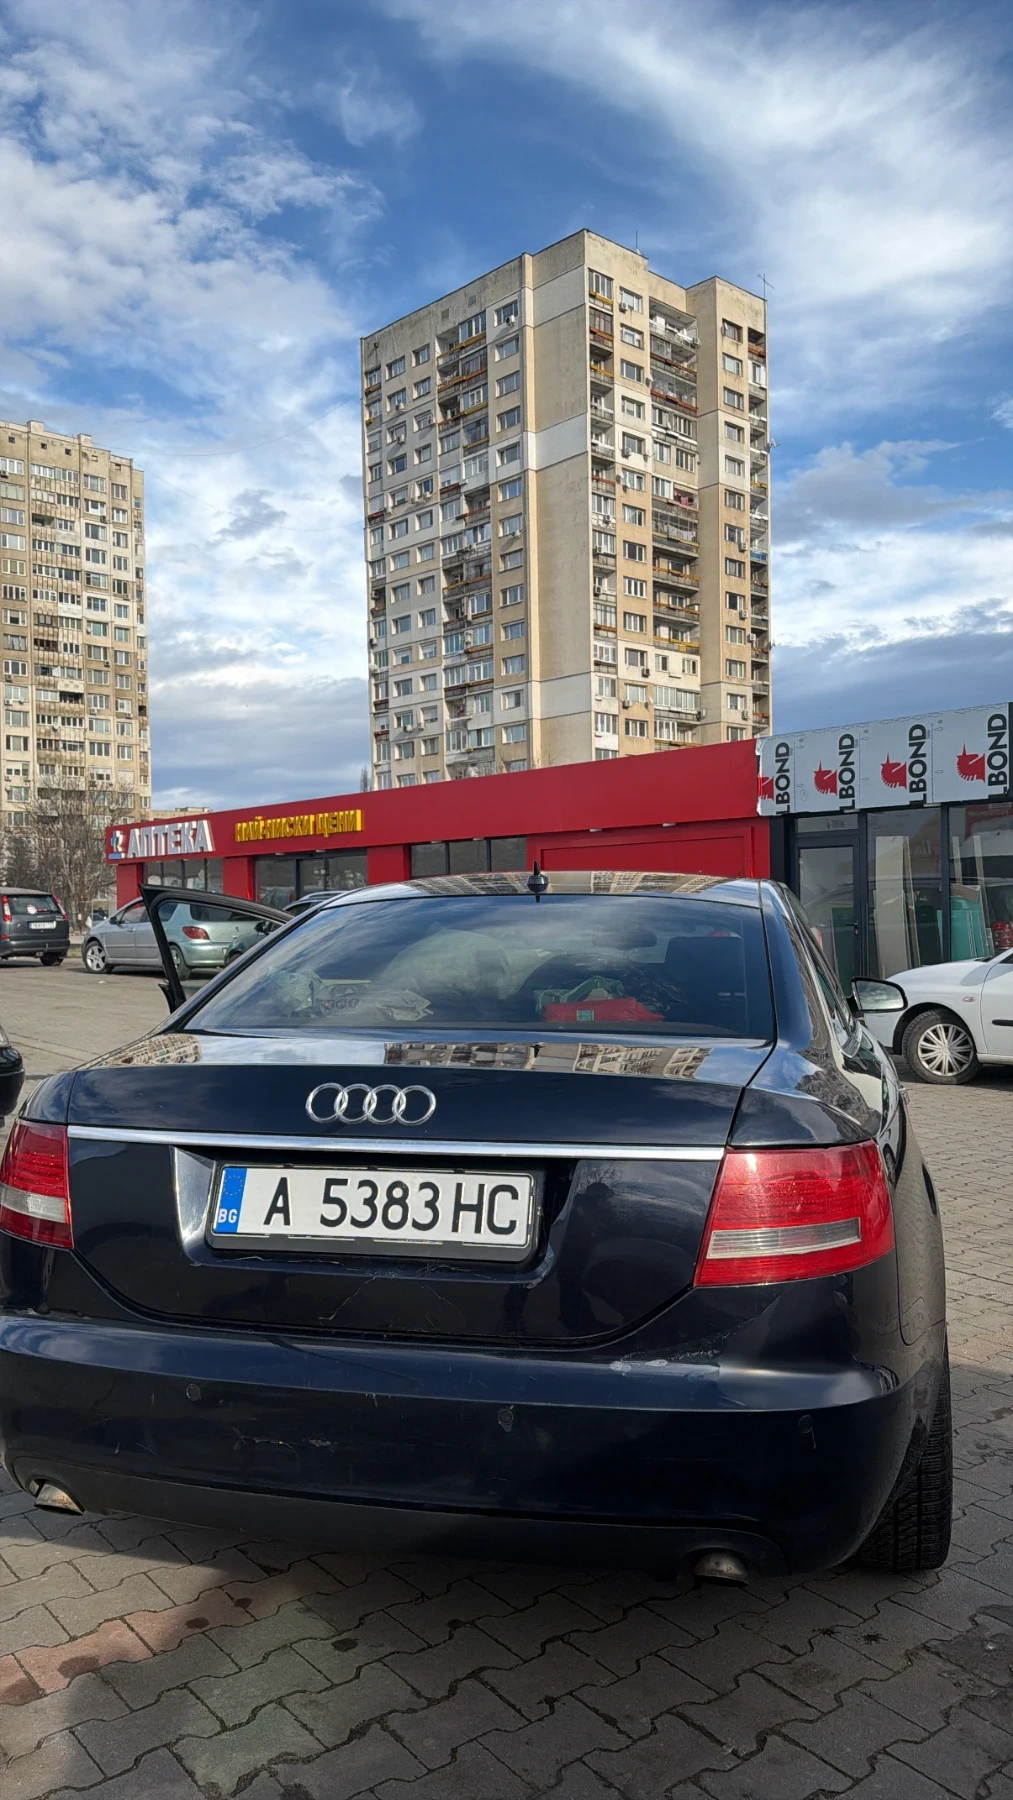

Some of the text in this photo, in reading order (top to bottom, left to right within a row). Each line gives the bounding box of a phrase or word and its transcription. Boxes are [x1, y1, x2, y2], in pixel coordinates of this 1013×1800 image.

[127, 820, 215, 858] АПТЕКА
[316, 809, 363, 838] ЦЕНИ
[217, 1208, 238, 1224] BG
[320, 1178, 440, 1232] 5383
